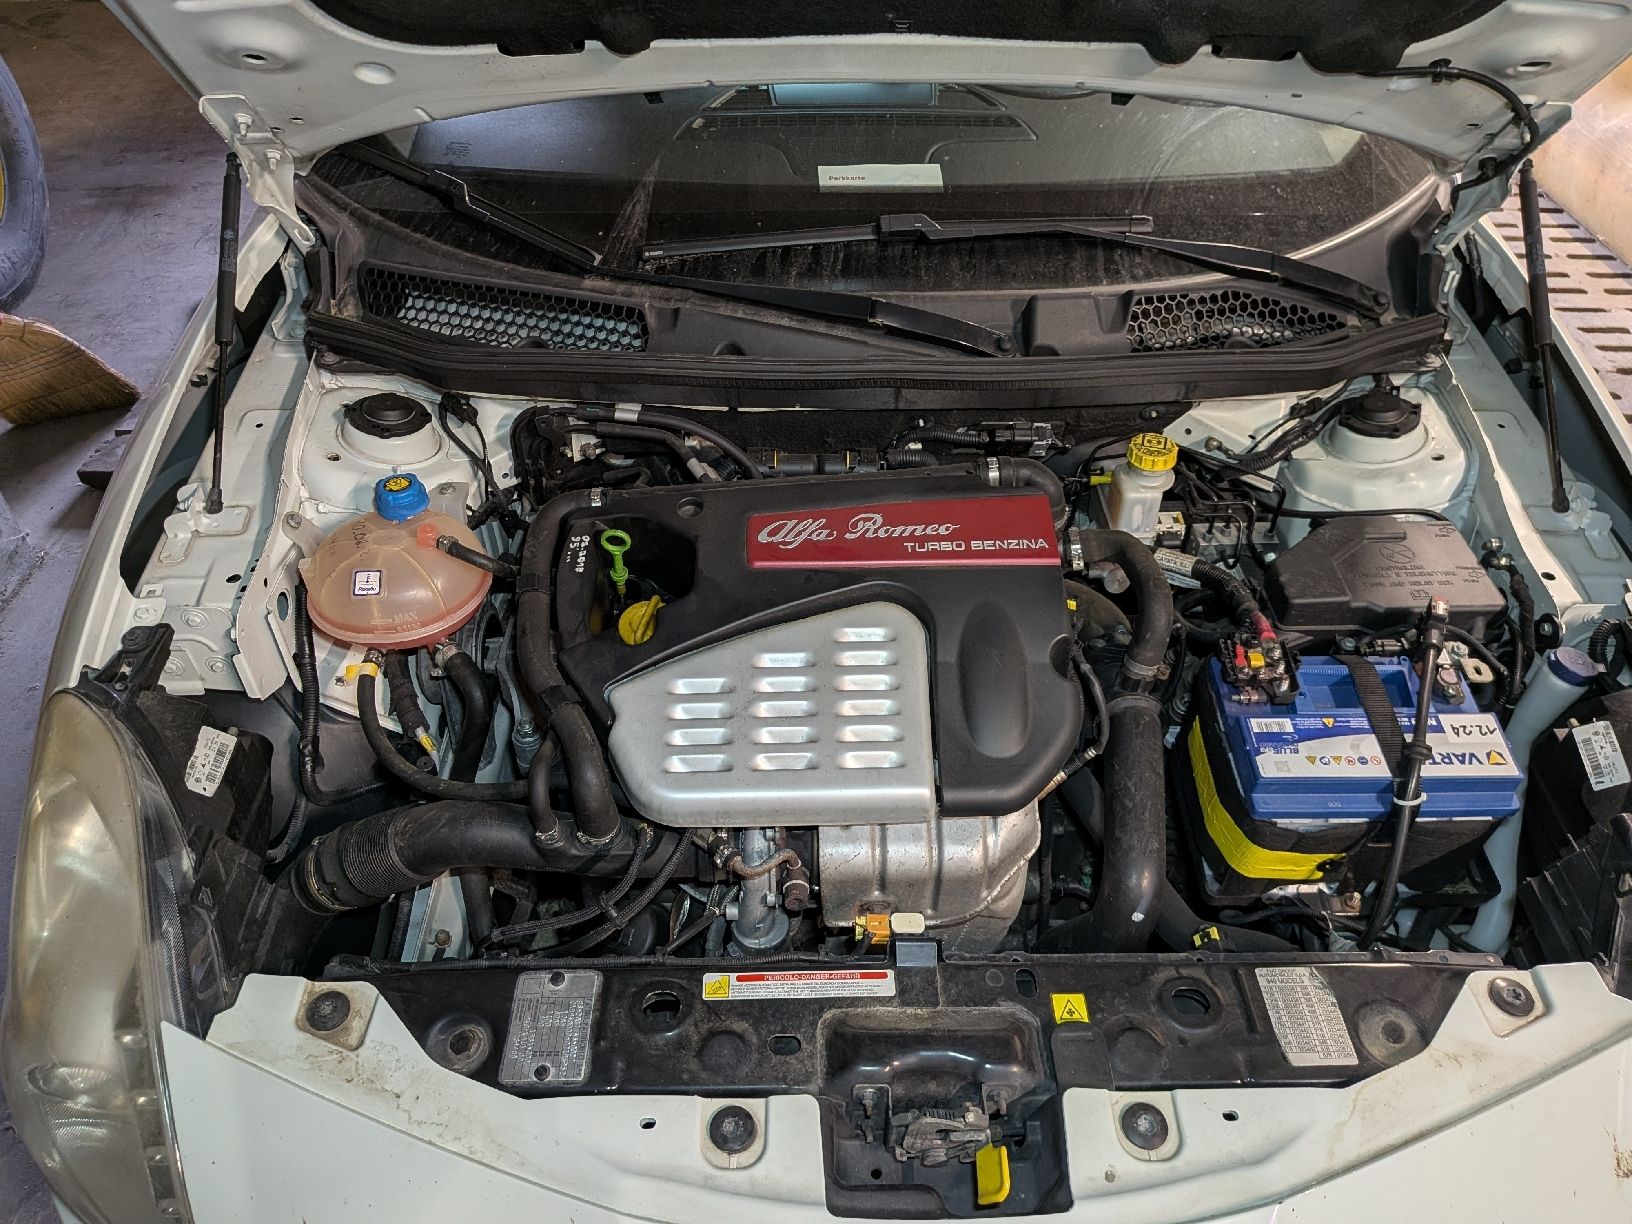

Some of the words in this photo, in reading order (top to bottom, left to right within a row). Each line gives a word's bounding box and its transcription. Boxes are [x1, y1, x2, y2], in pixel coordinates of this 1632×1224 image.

[757, 518, 837, 549] Alfa
[844, 513, 961, 539] Romeo
[904, 541, 965, 553] TURBO
[971, 539, 1049, 551] BENZINA
[1449, 723, 1498, 738] 12.24
[1423, 751, 1484, 766] VART
